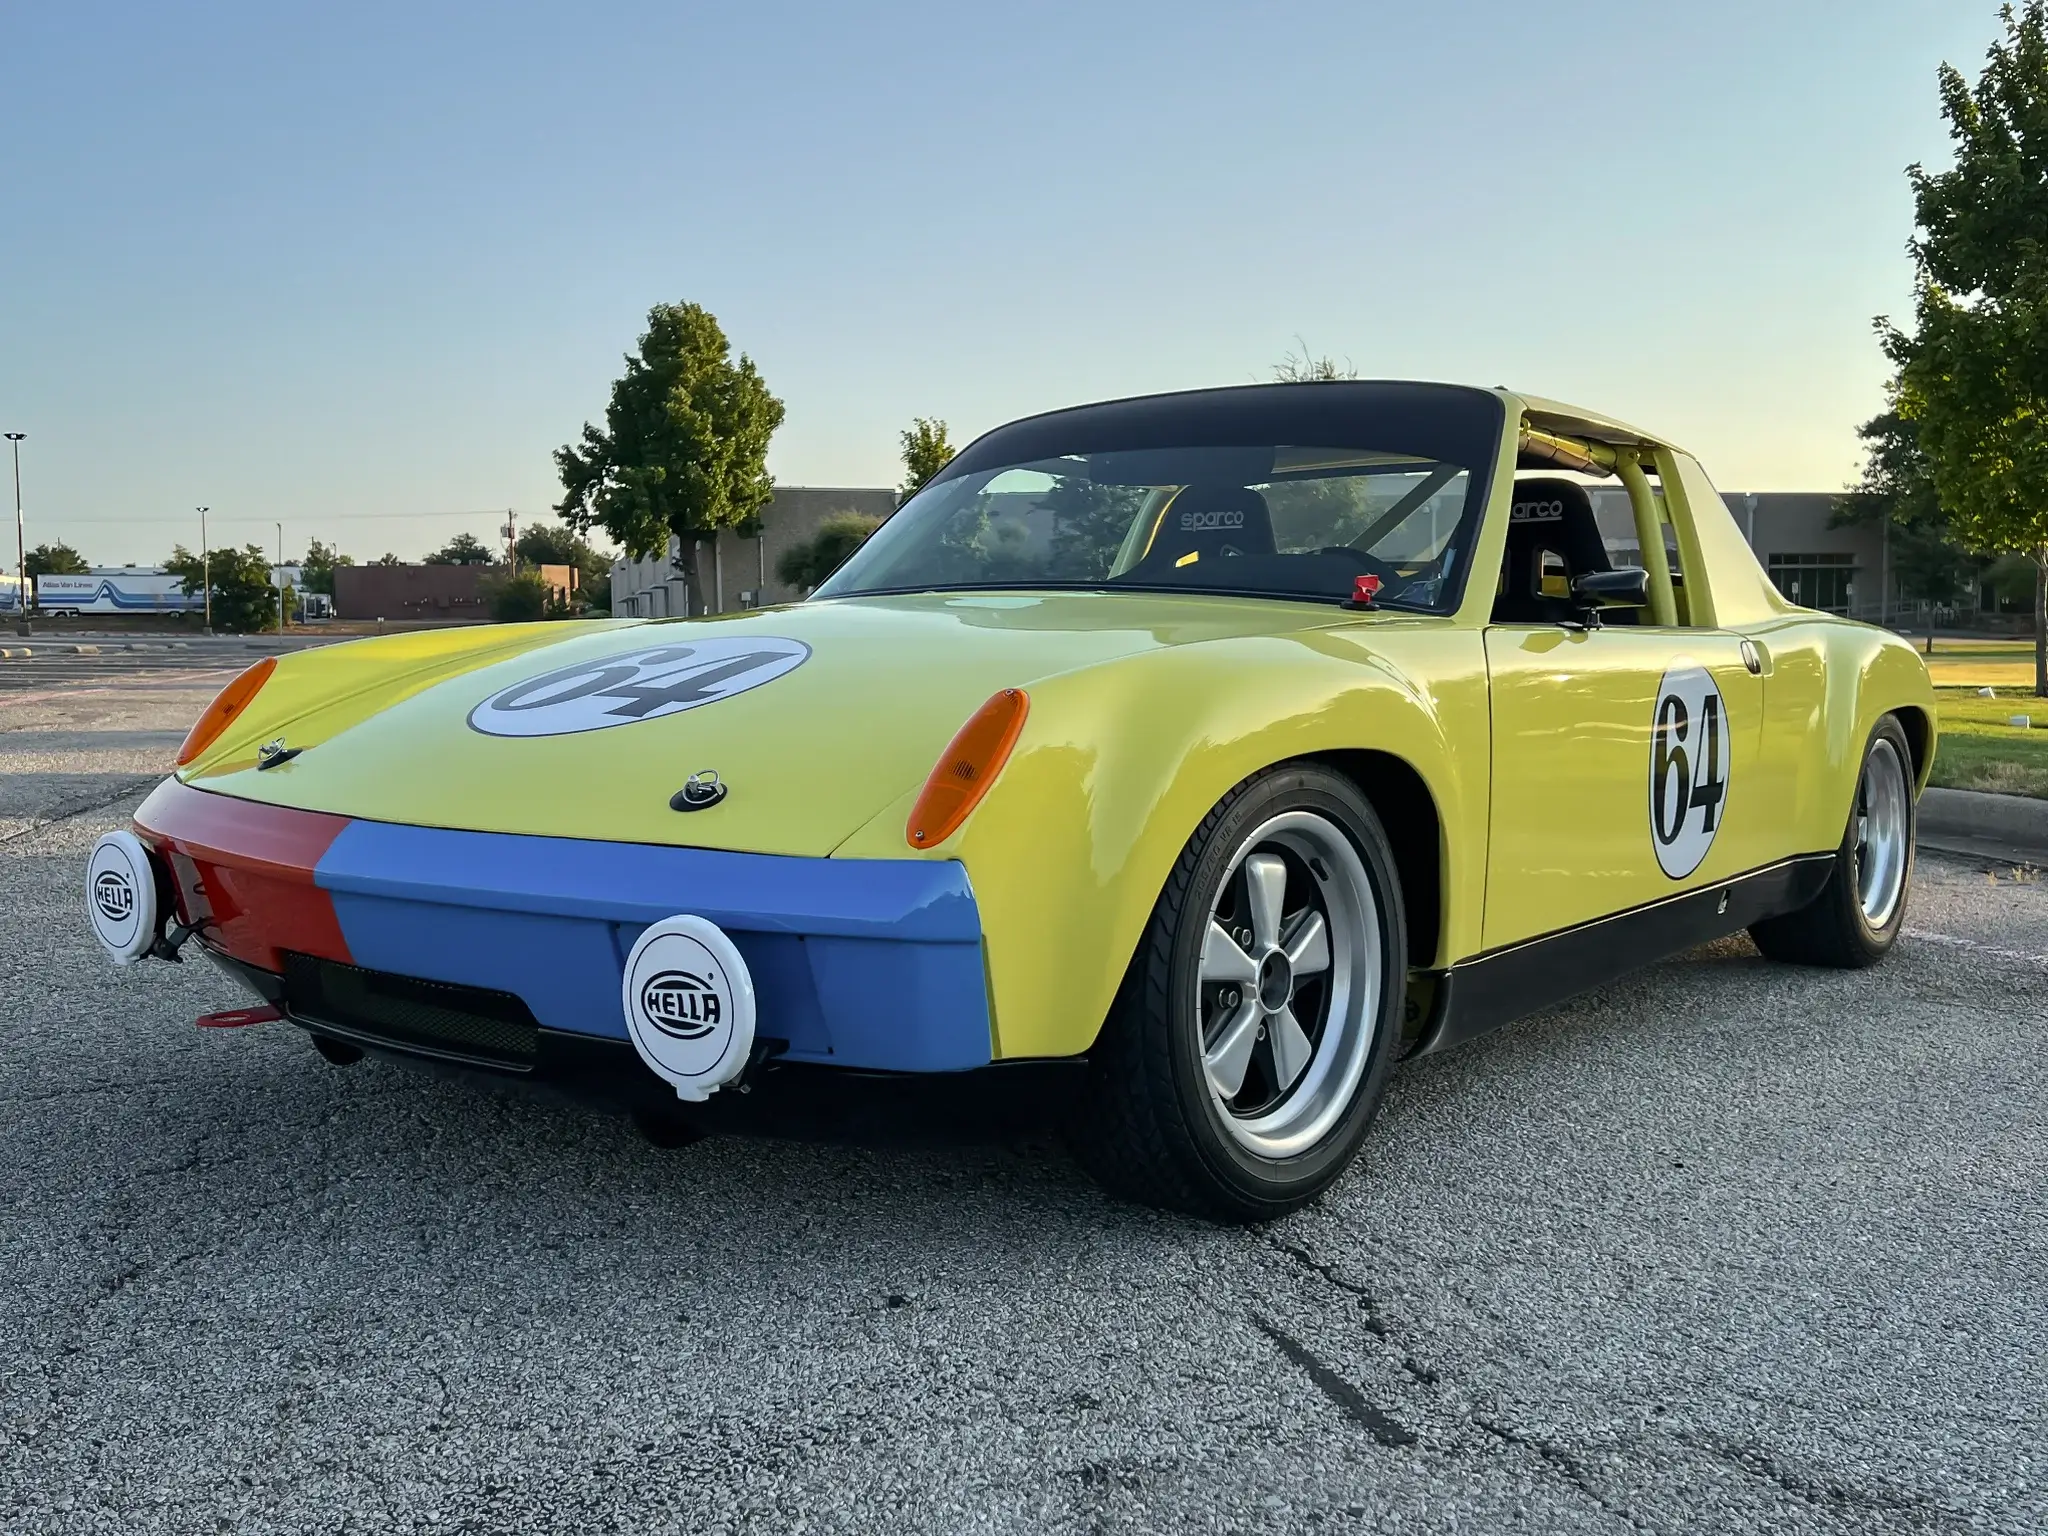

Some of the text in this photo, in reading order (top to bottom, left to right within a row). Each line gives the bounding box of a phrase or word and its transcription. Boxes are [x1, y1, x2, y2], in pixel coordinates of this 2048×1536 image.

[1180, 510, 1244, 532] sparco
[1511, 500, 1563, 522] arco
[490, 647, 801, 718] 64
[1654, 694, 1725, 845] 64
[97, 886, 133, 910] HELLA
[647, 992, 721, 1024] HELLA
